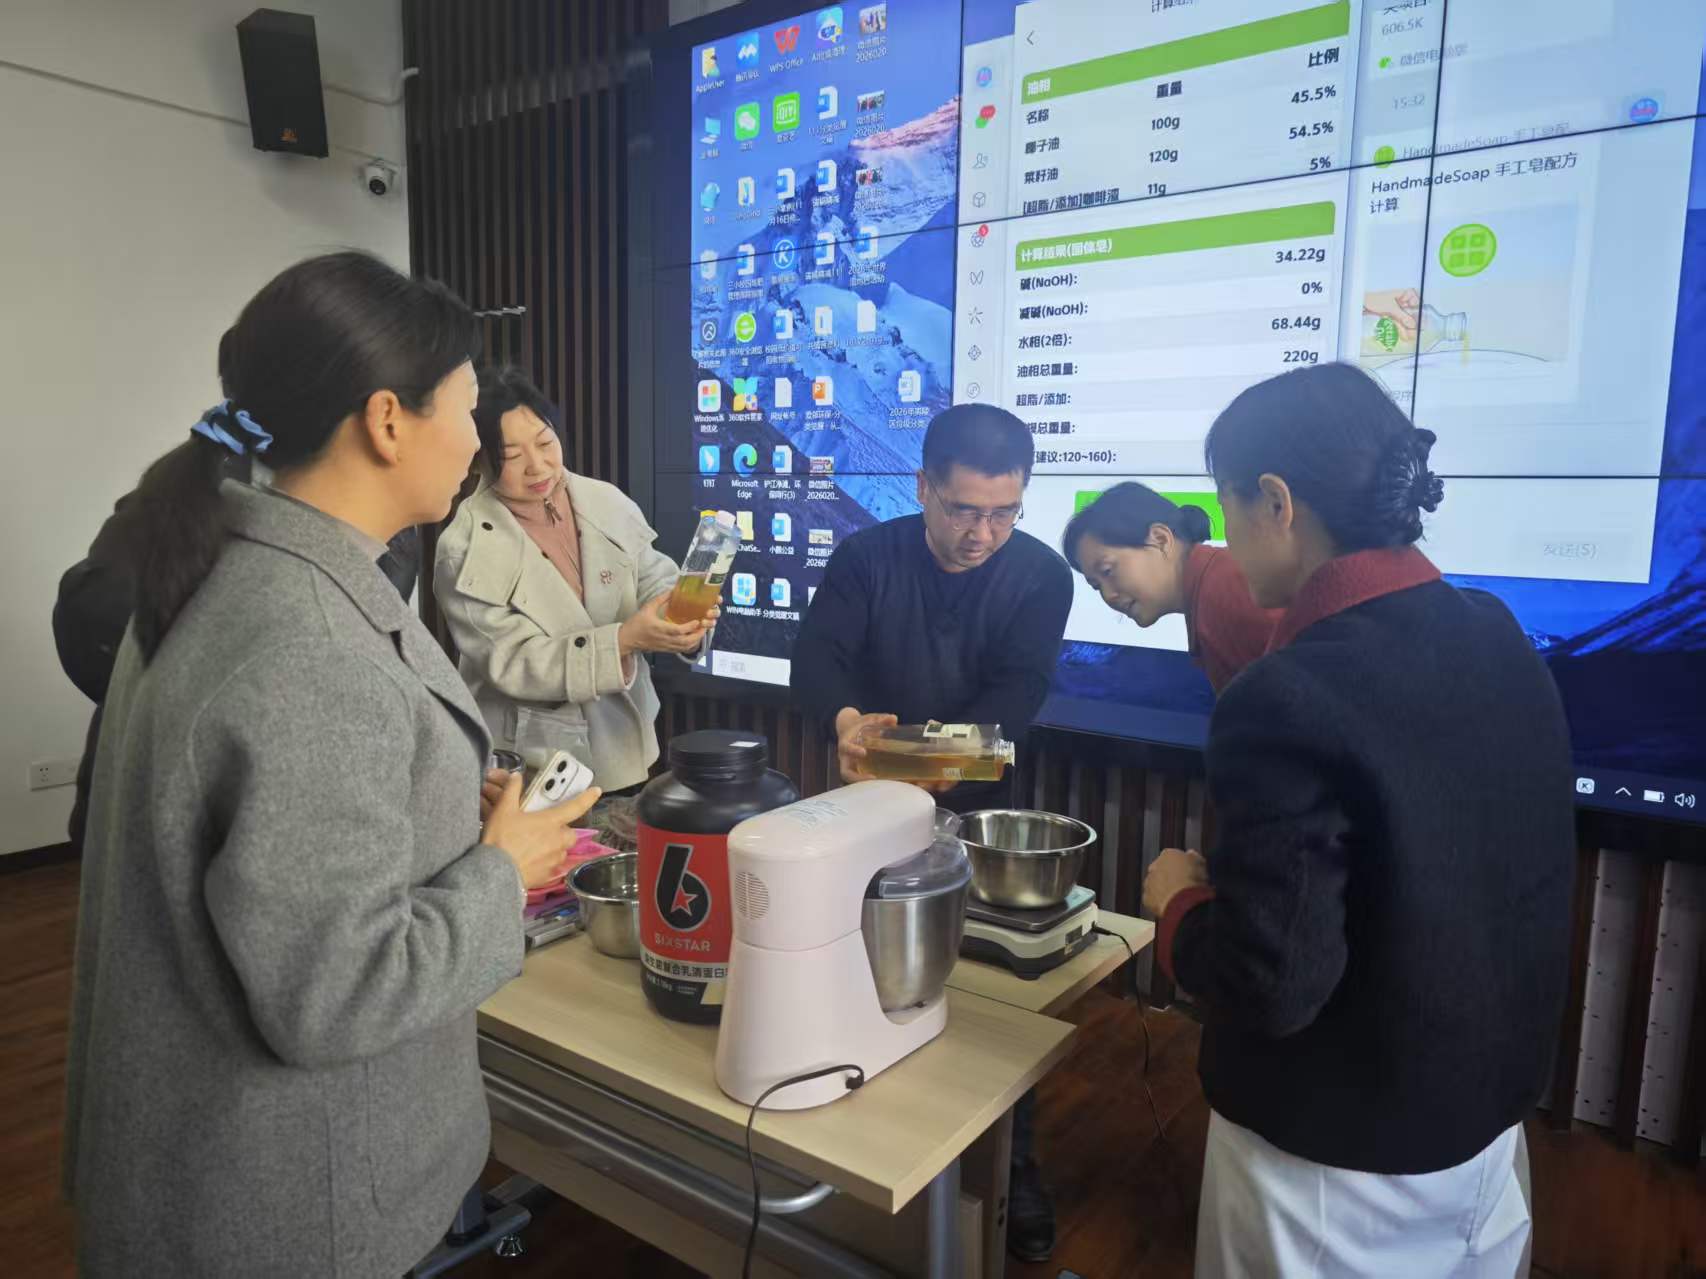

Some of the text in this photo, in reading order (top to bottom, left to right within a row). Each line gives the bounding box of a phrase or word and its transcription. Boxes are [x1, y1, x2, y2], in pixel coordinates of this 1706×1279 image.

[1308, 47, 1340, 68] 比例
[1291, 85, 1336, 104] 45.5%
[1026, 108, 1049, 125] 名称
[1151, 116, 1180, 131] 100g
[1289, 121, 1334, 140] 54.5%
[1024, 137, 1060, 154] 椰子油
[1149, 149, 1178, 163] 120g
[1309, 156, 1331, 170] 5%
[1024, 168, 1059, 185] 菜籽油
[1371, 152, 1578, 194] HandmadeSoap 手工皂配方
[1147, 183, 1167, 196] 11g
[1370, 197, 1400, 214] 计算
[1275, 248, 1325, 263] 34.22g
[1020, 273, 1078, 291] 碱(NaOH):
[1301, 281, 1323, 295] 0%
[1271, 316, 1321, 331] 68.44g
[1018, 333, 1072, 349] 水相(2倍):
[1283, 350, 1319, 364] 220g
[1016, 362, 1078, 378] 油相总重量:
[1016, 393, 1071, 407] 超脂/添加:
[731, 479, 759, 488] Microsoft
[737, 489, 753, 499] Edge
[655, 932, 711, 952] SIXSTAR
